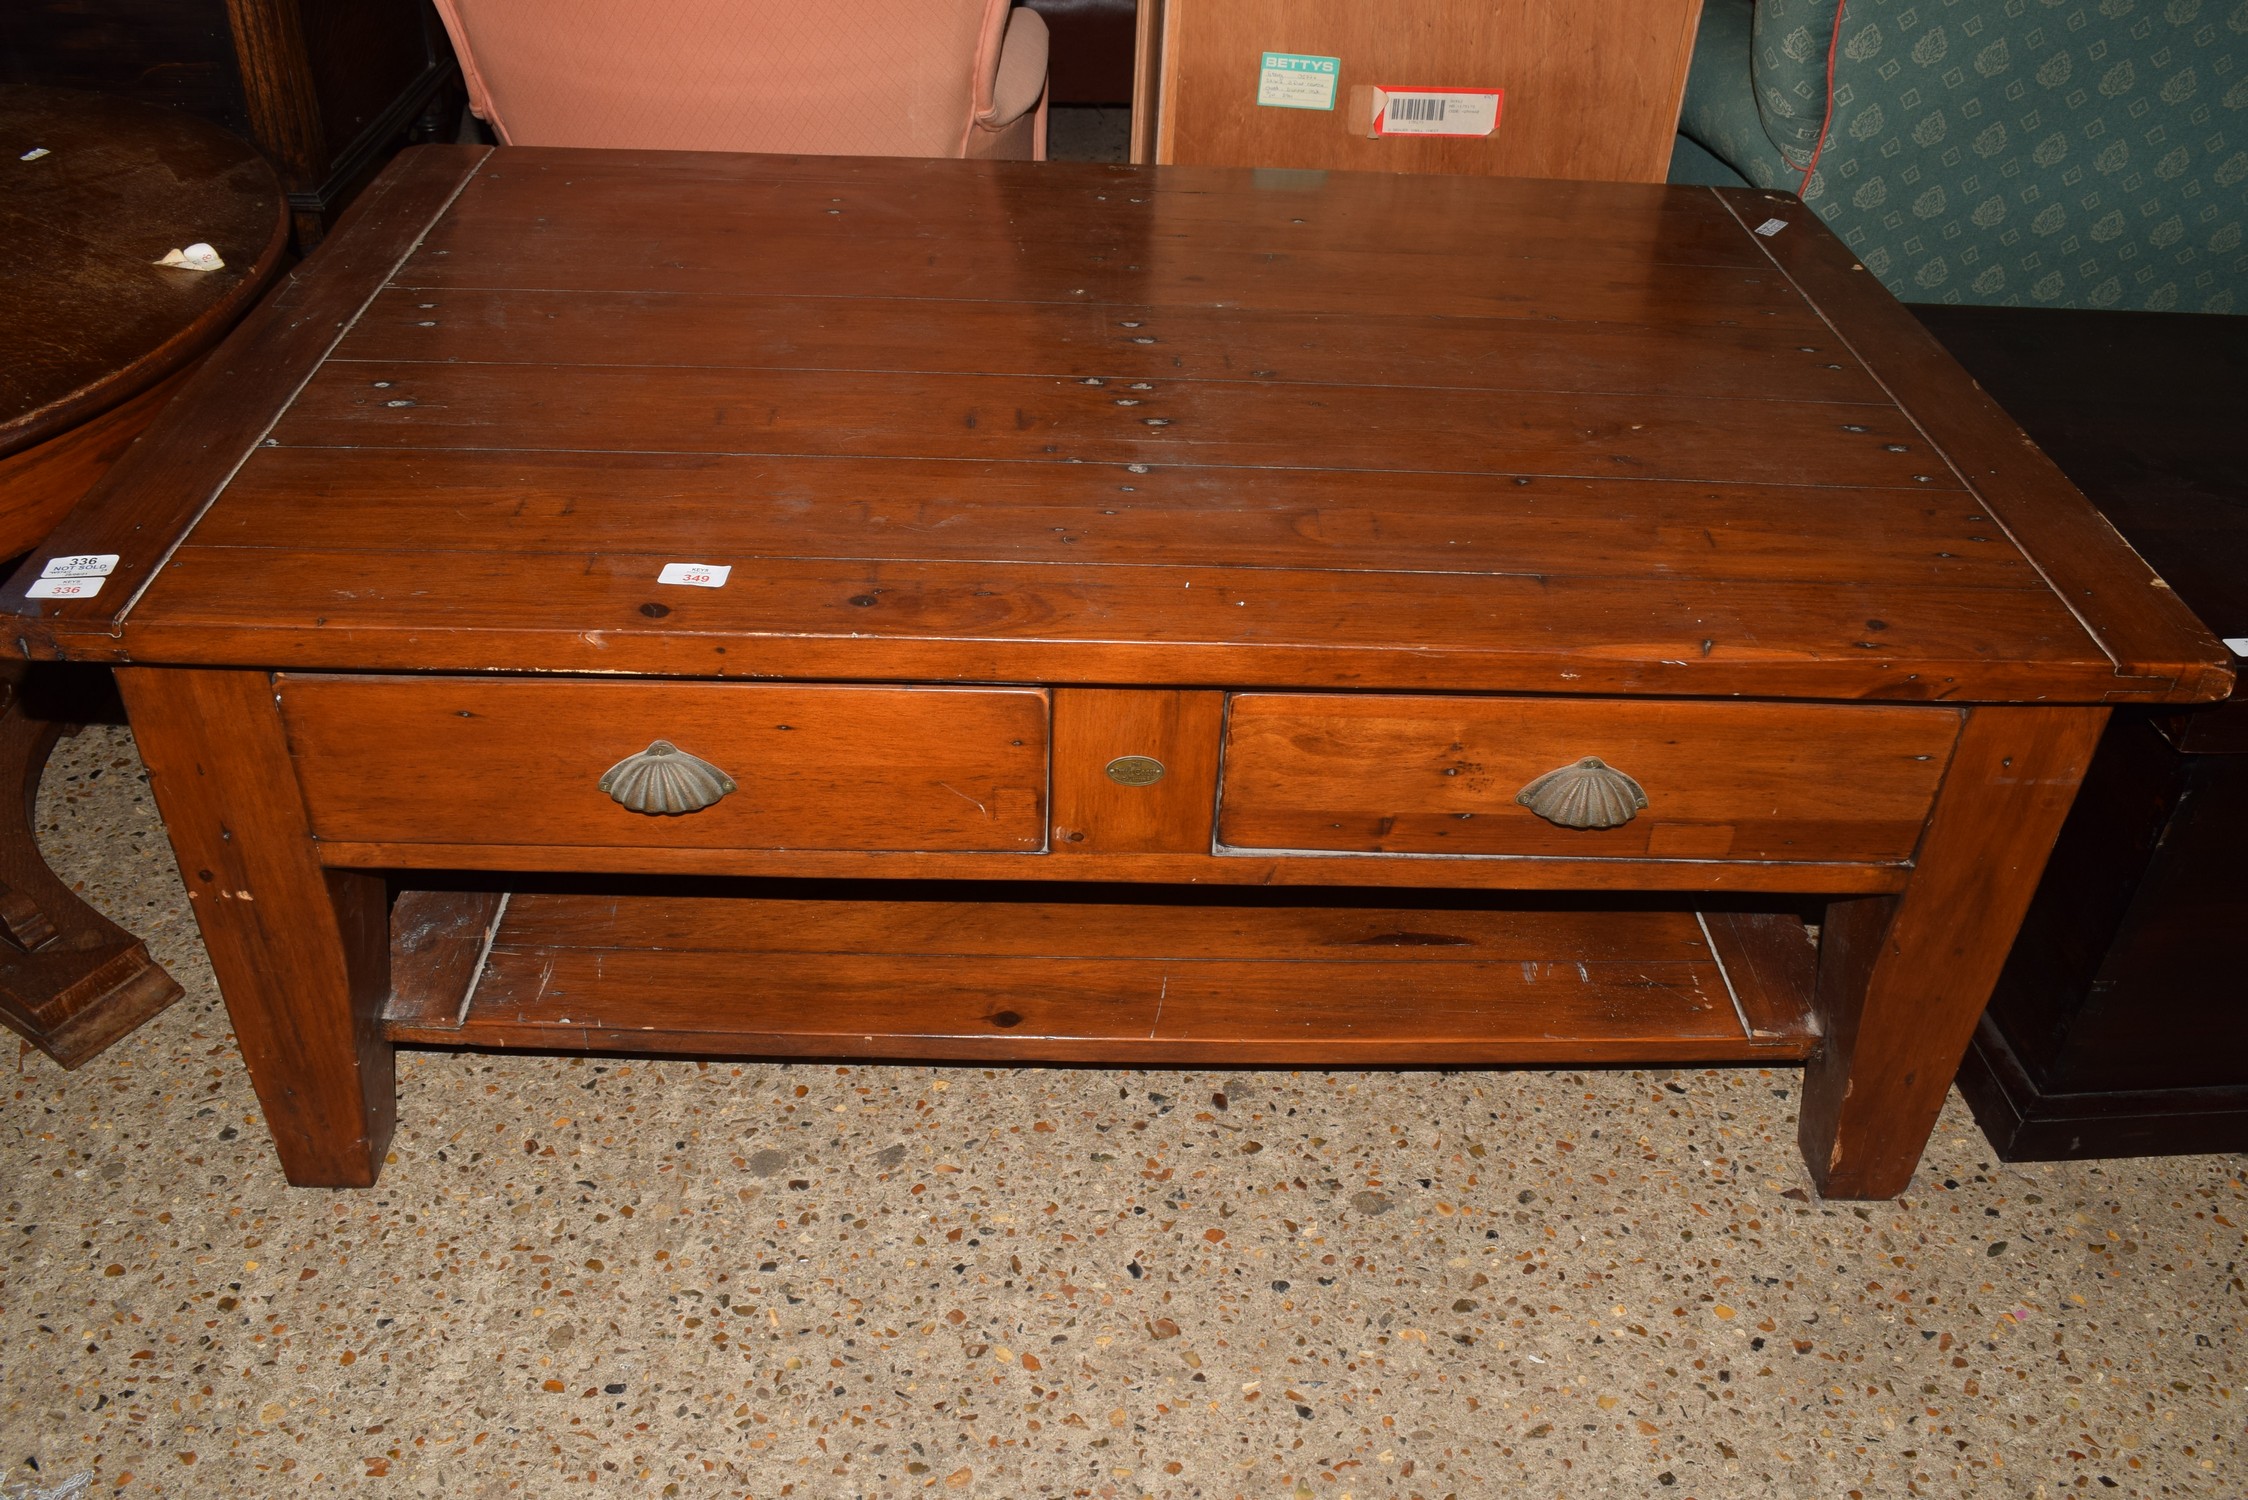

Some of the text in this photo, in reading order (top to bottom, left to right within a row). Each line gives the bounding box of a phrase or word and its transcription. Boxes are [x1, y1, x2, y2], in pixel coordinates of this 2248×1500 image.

[1266, 57, 1333, 72] BETTYS
[69, 557, 98, 566] 336
[682, 574, 710, 583] 349
[51, 586, 81, 594] 336
